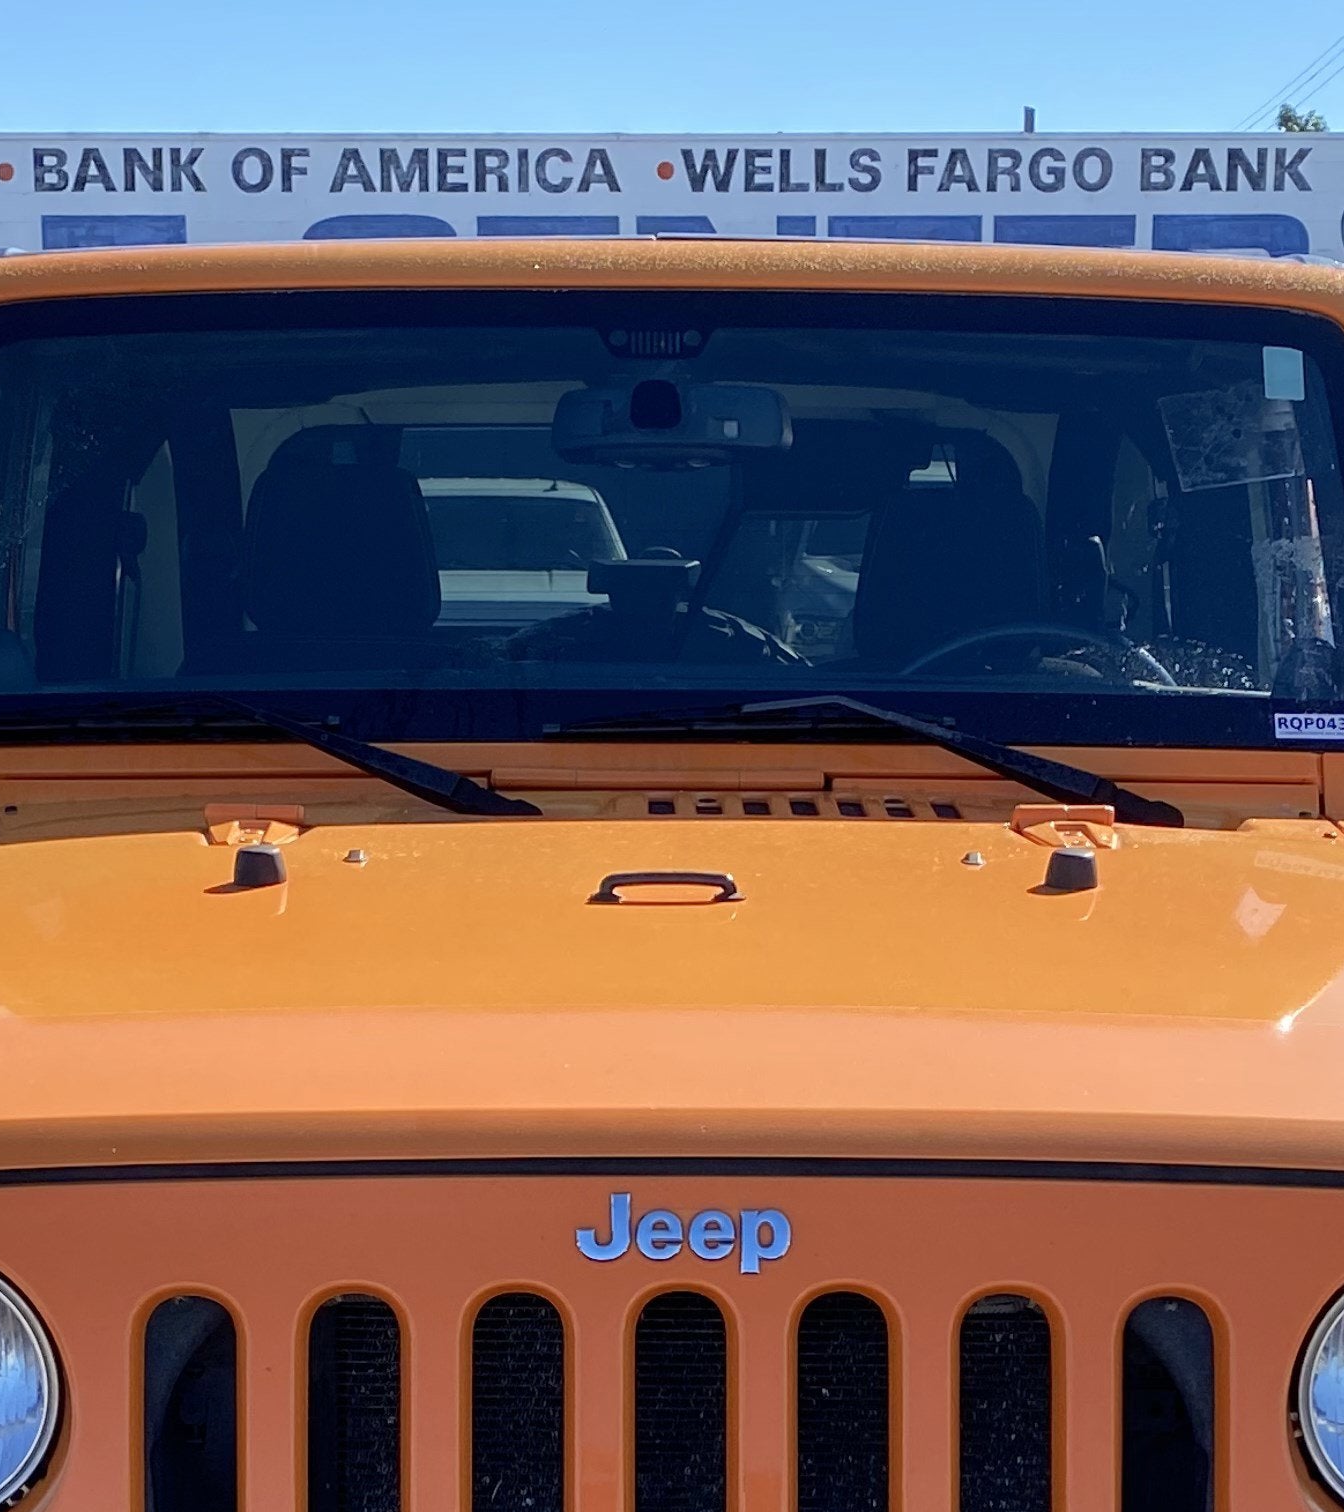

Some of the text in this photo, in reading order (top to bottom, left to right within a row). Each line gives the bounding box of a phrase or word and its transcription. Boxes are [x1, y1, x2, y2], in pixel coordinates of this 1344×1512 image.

[33, 147, 206, 193] BANK
[232, 147, 309, 193] OF
[330, 147, 622, 193] AMERICA
[680, 148, 882, 193] WELLS
[908, 147, 1113, 193] FARGO
[1141, 147, 1313, 192] BANK
[575, 1192, 792, 1275] Jeep
